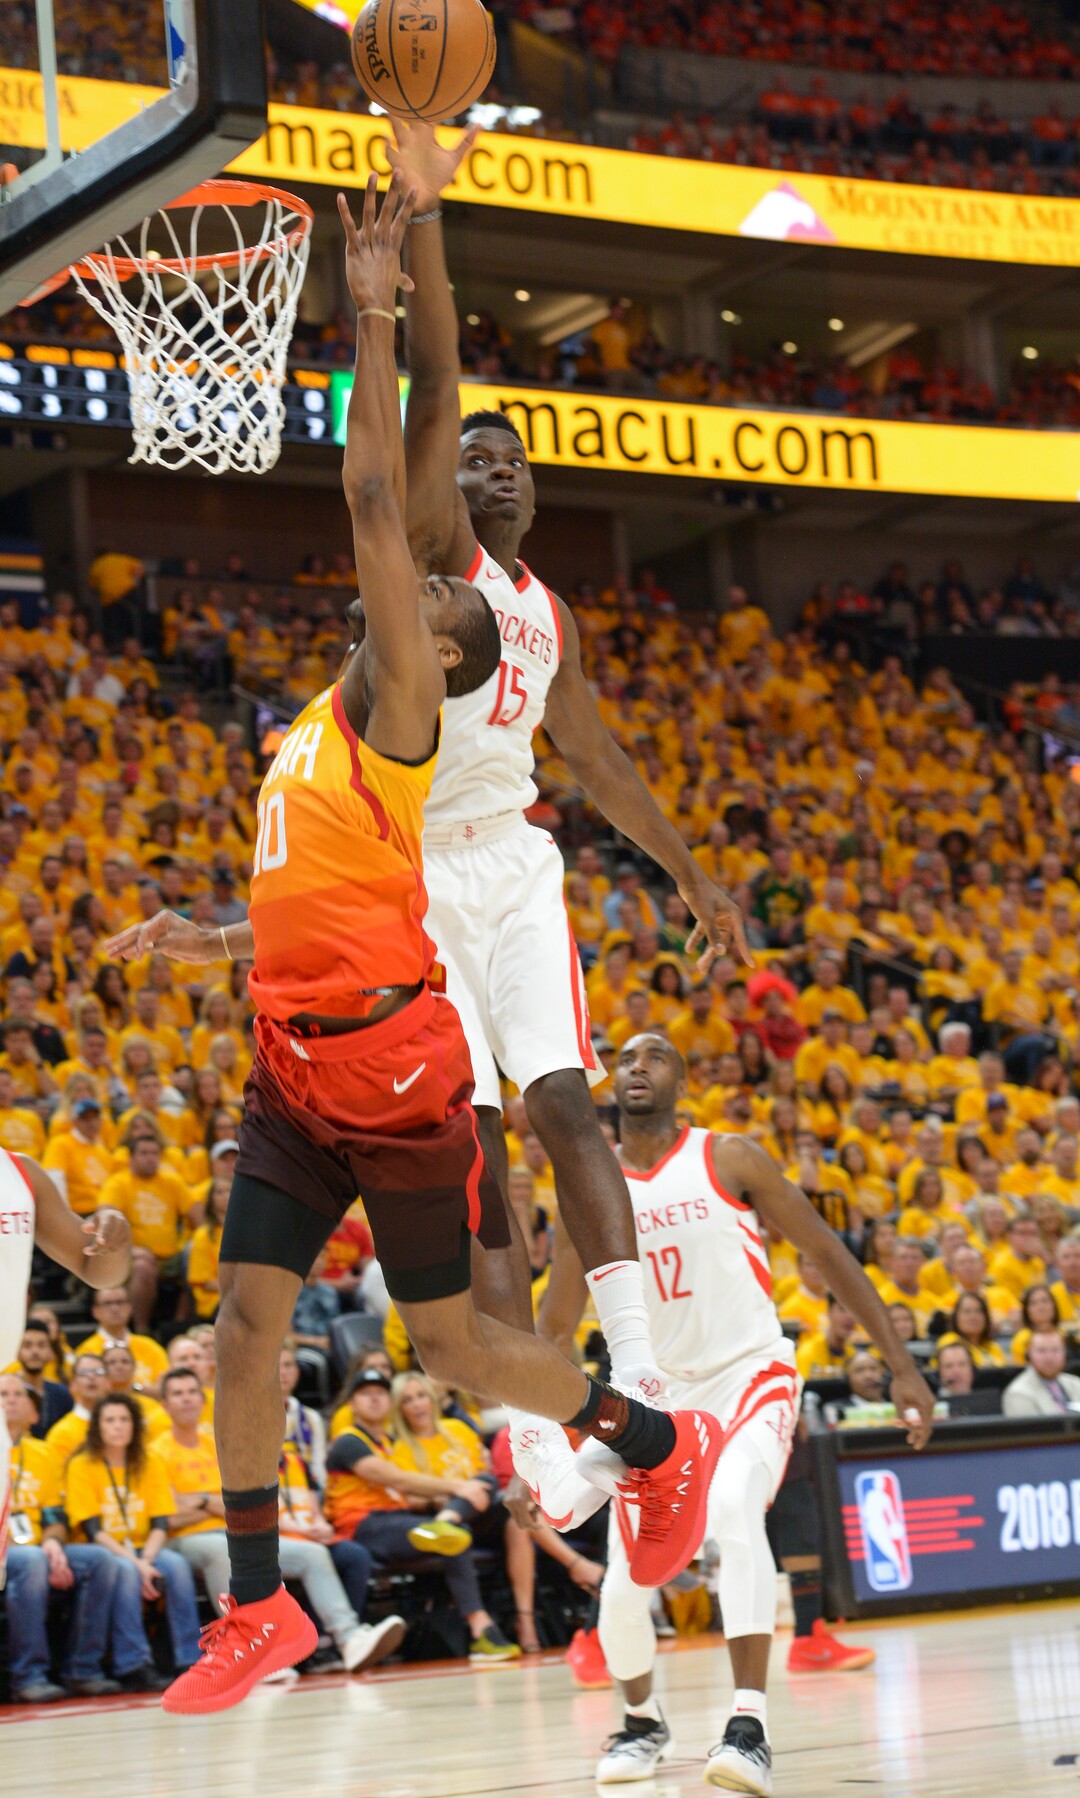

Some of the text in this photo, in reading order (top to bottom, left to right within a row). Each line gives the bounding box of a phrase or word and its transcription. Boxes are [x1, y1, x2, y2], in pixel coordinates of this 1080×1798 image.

[365, 0, 391, 82] SPALD
[266, 121, 592, 204] mac.com
[500, 399, 878, 481] macu.com
[486, 659, 528, 727] 15
[637, 1198, 709, 1234] CKETS
[646, 1246, 693, 1302] 12
[997, 1480, 1071, 1552] 2018
